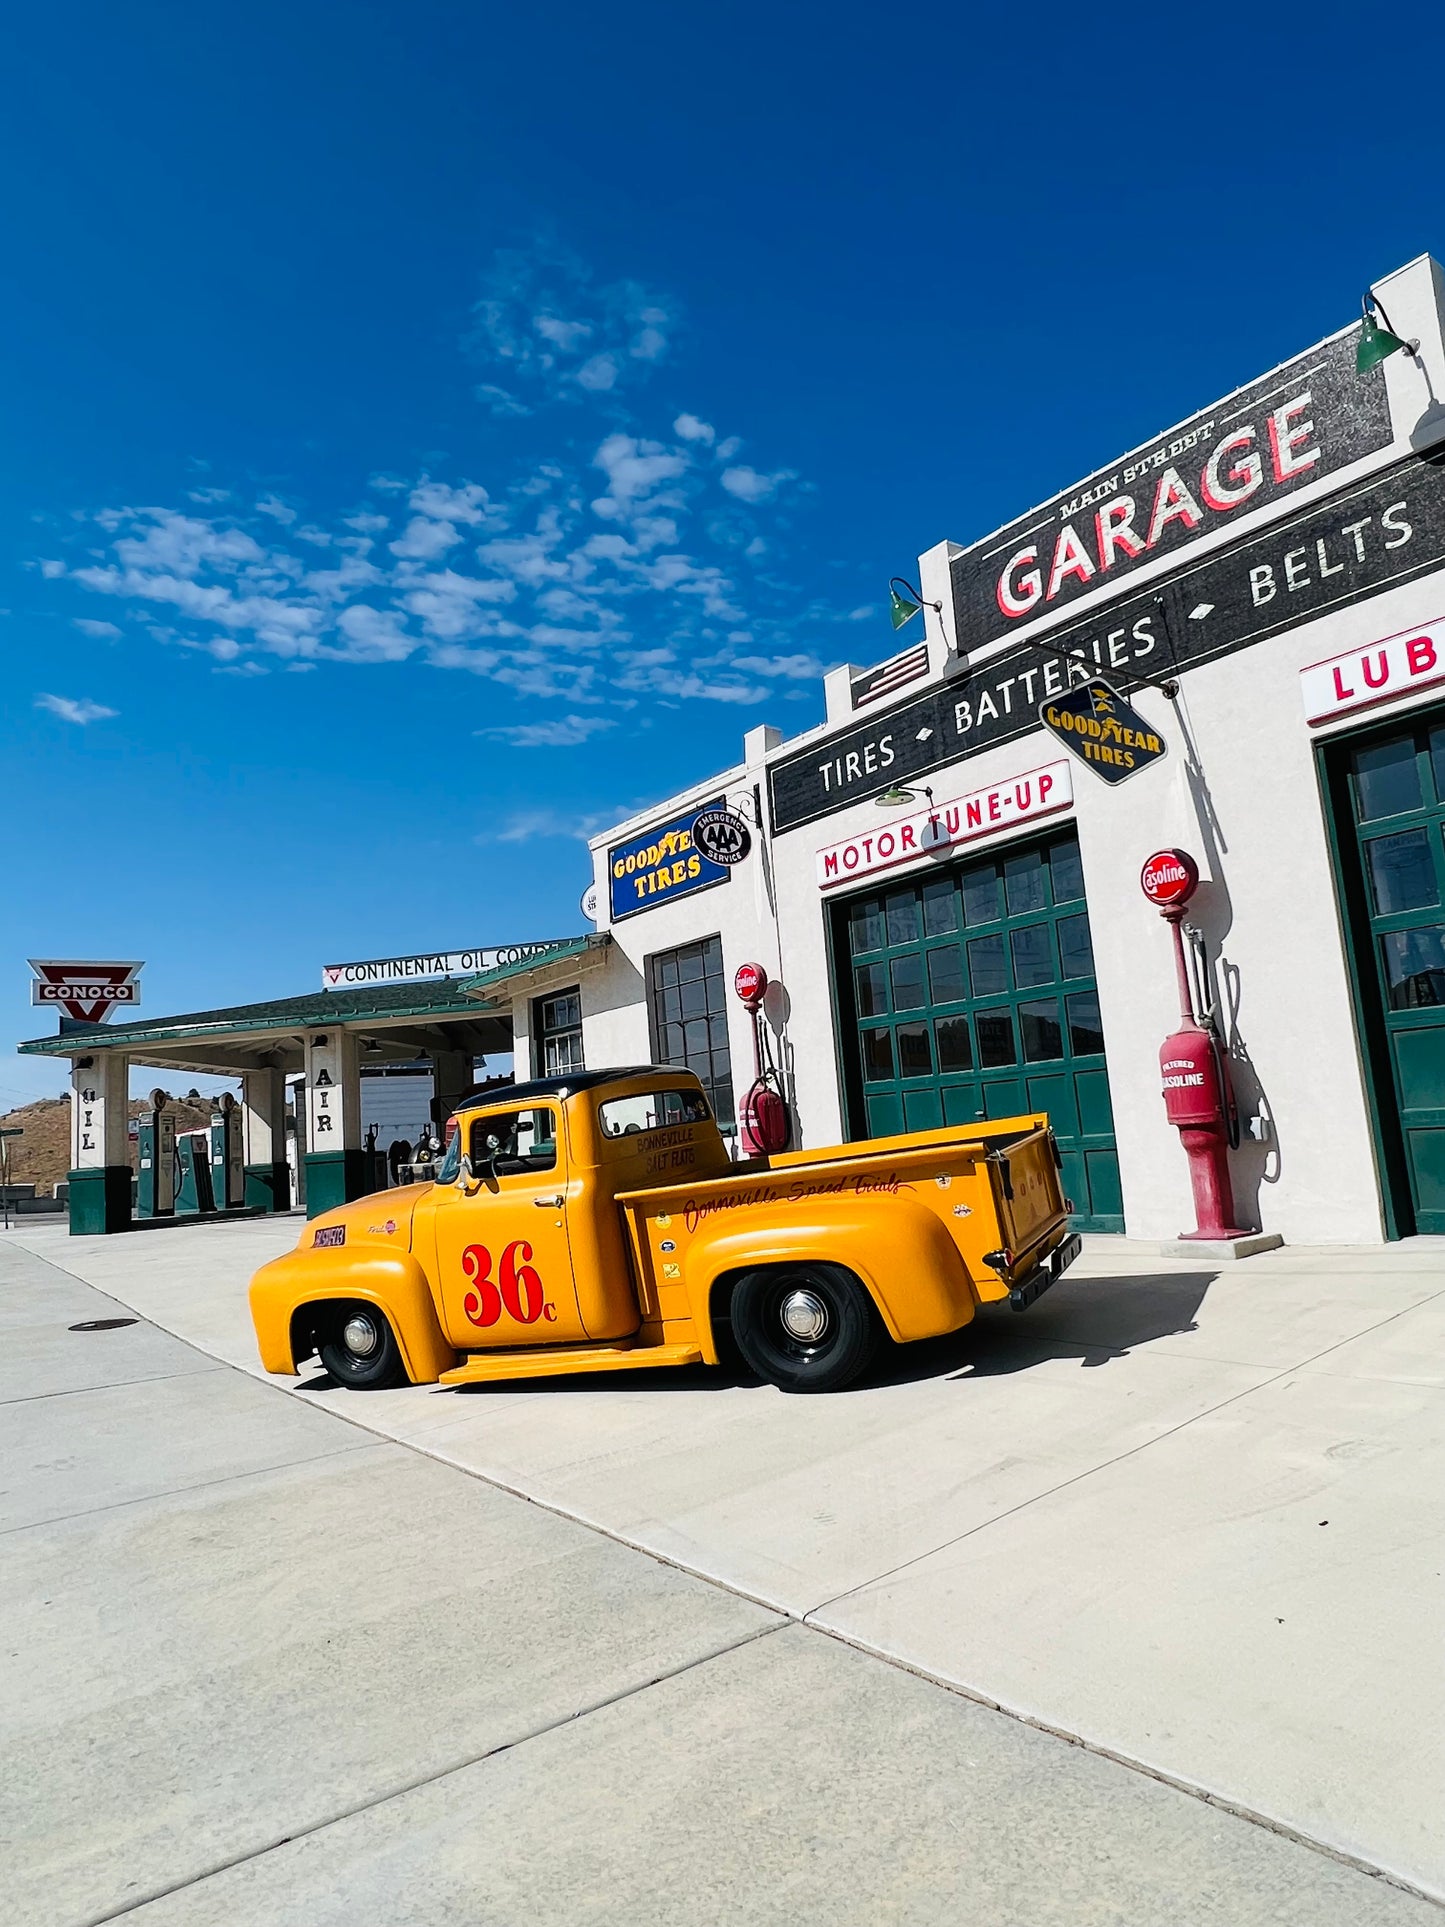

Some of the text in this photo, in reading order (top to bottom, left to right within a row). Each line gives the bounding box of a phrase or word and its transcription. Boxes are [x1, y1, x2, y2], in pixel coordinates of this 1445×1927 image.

[1059, 420, 1215, 520] MAIN STREET
[997, 392, 1322, 618] GARAGE
[819, 501, 1414, 792] TIRES BATTERIES BELTS
[1333, 636, 1438, 701] LUB
[1047, 706, 1160, 753] GOODYEAR
[1081, 741, 1135, 769] TIRES
[697, 814, 746, 834] EMERGENCY
[702, 825, 740, 852] AAA
[824, 774, 1054, 878] MOTOR TUNE-UP
[613, 830, 696, 879] GOODYE
[634, 854, 701, 898] TIRES
[707, 849, 742, 863] SERVICE
[1143, 863, 1186, 895] Gasoline
[345, 957, 453, 982] CONTINENTAL
[461, 953, 489, 970] OIL
[44, 986, 129, 999] CONOCO
[82, 1088, 97, 1150] OIL
[315, 1068, 333, 1132] AIR
[637, 1127, 695, 1153] BONNEVILLE
[647, 1152, 669, 1175] SALT
[683, 1187, 784, 1233] Bonneville
[786, 1176, 848, 1202] Speed
[850, 1172, 918, 1195] Trials
